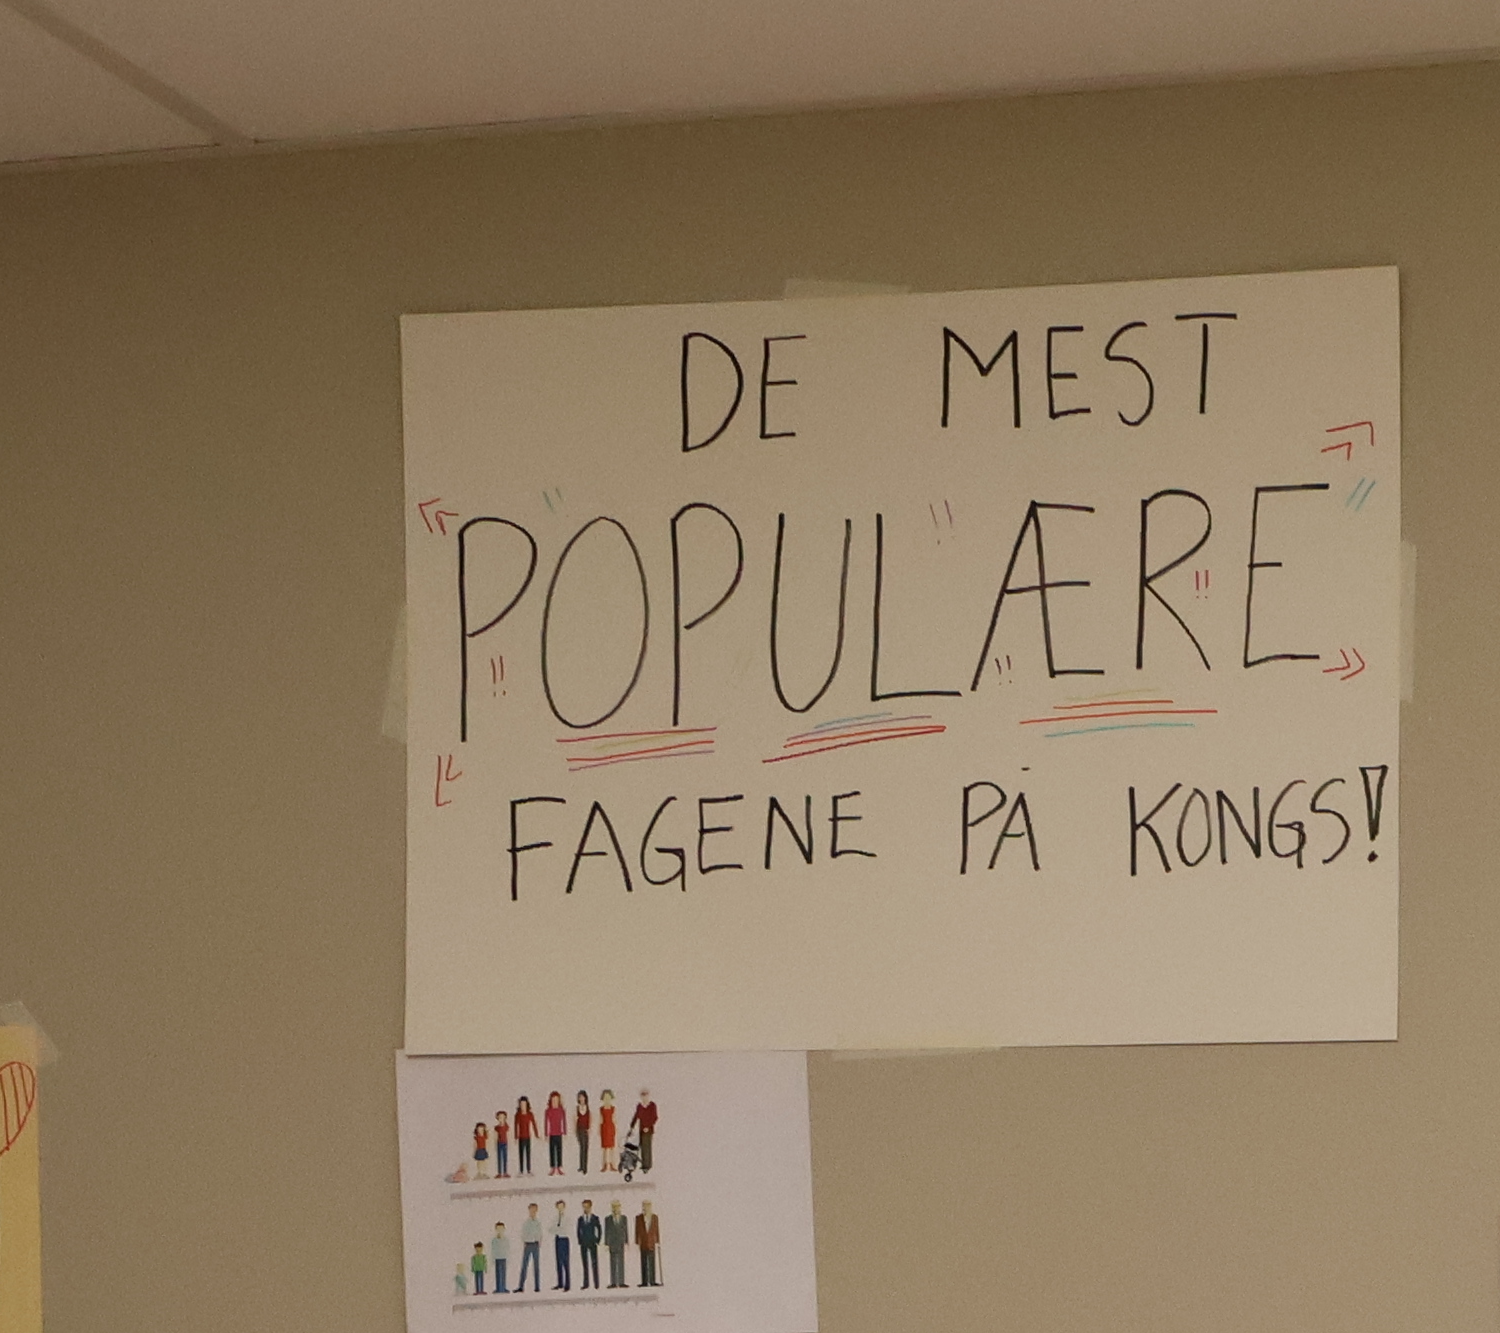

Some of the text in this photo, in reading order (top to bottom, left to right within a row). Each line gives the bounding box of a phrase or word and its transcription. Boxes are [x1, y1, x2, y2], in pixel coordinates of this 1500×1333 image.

[681, 312, 1238, 454] DE MEST
[456, 483, 1330, 743] POPULÆRE
[508, 763, 1389, 901] FAGENE PÅ KONGS!
